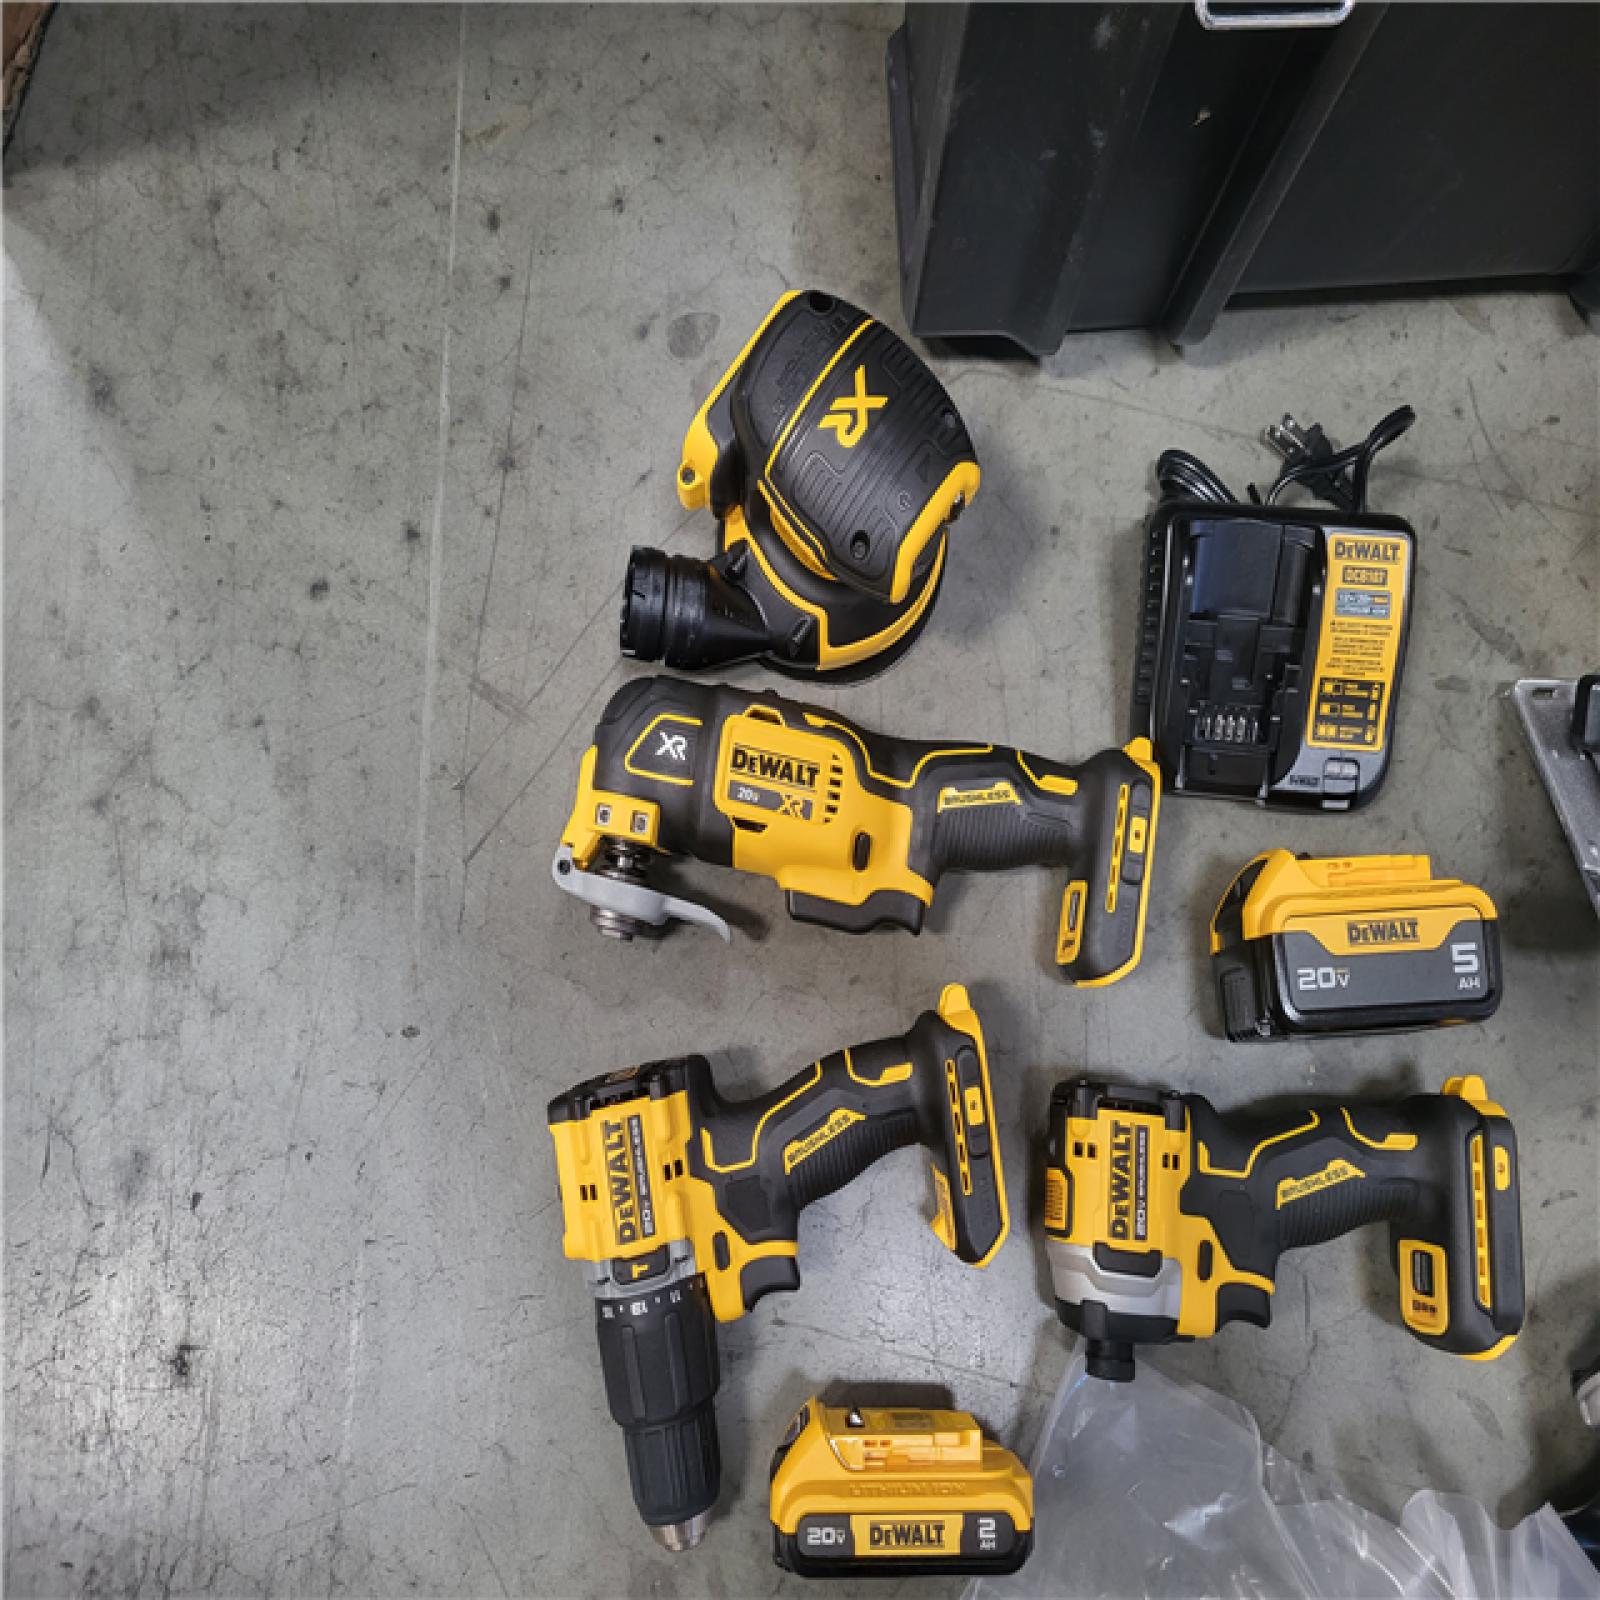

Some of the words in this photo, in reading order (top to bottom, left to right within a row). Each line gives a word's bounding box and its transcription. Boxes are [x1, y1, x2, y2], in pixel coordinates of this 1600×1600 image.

[817, 365, 889, 448] XR
[655, 731, 688, 760] XR
[944, 789, 1011, 806] BRUSHLESS
[1452, 942, 1479, 973] 5
[788, 1113, 850, 1163] BRUSHLESS
[630, 1118, 648, 1196] BRUSHLESS
[1280, 1166, 1350, 1198] BRUSHLESS
[978, 1518, 996, 1539] 2
